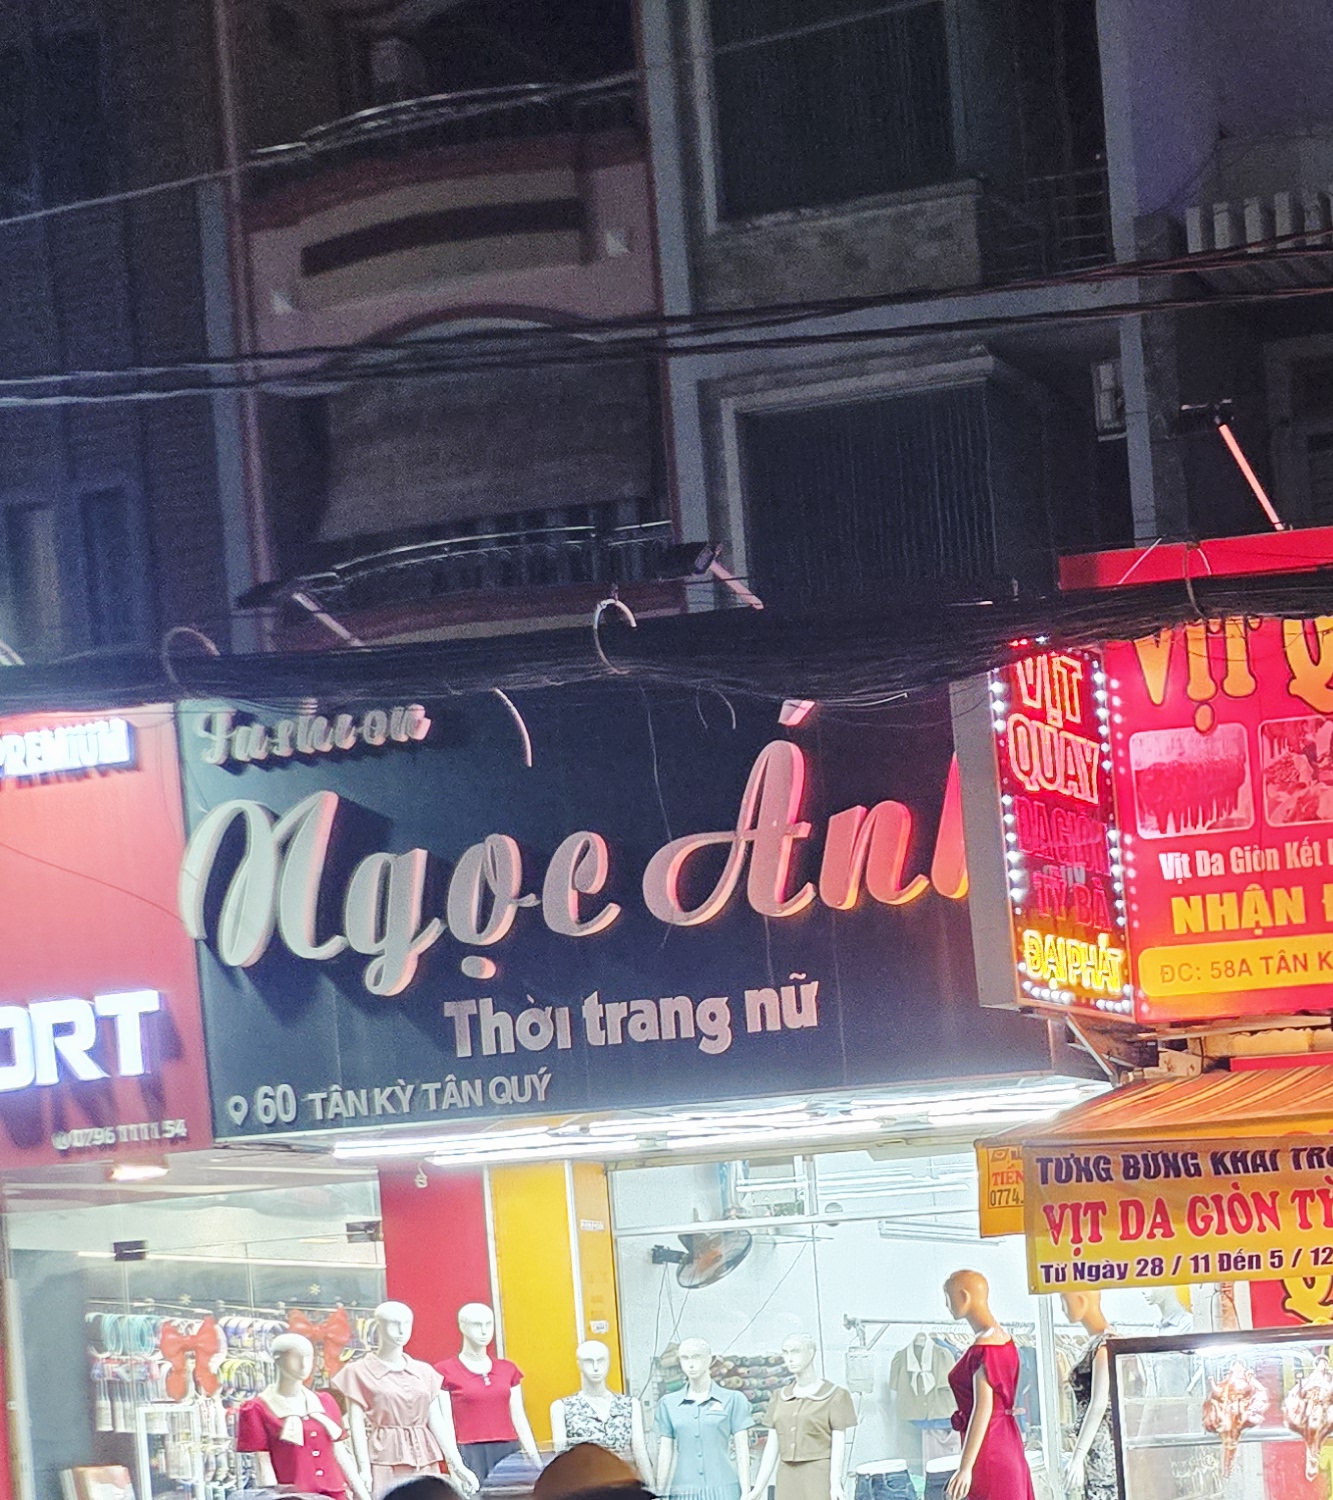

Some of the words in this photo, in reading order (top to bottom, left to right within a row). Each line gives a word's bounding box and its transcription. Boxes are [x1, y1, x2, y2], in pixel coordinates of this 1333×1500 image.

[0, 716, 131, 777] REMIUM
[1007, 713, 1100, 804] QUAY
[1159, 851, 1192, 884] Vịt
[1196, 850, 1224, 877] Da
[1230, 843, 1281, 875] Giòn
[1286, 836, 1322, 869] Kết
[1171, 883, 1306, 936] NHẬN
[1210, 957, 1253, 981] 58A
[1260, 946, 1309, 975] TÂN
[443, 994, 572, 1058] Thời
[582, 990, 732, 1055] trang
[744, 972, 819, 1033] nữ
[257, 1083, 296, 1124] 60
[307, 1084, 368, 1121] TÂN
[374, 1078, 415, 1115] KỲ
[422, 1073, 483, 1110] TÂN
[488, 1066, 551, 1105] QUÝ
[1210, 1146, 1281, 1176] KHAI
[1042, 1200, 1107, 1257] VỊT
[1118, 1197, 1175, 1242] DA
[1186, 1181, 1282, 1238] GIÒN
[1040, 1259, 1067, 1284] Từ
[1073, 1260, 1128, 1283] Ngày
[1136, 1258, 1160, 1278] 28
[1190, 1254, 1211, 1275] 11
[1217, 1247, 1262, 1273] Đến
[1270, 1249, 1284, 1269] 5
[1311, 1246, 1333, 1266] 12
